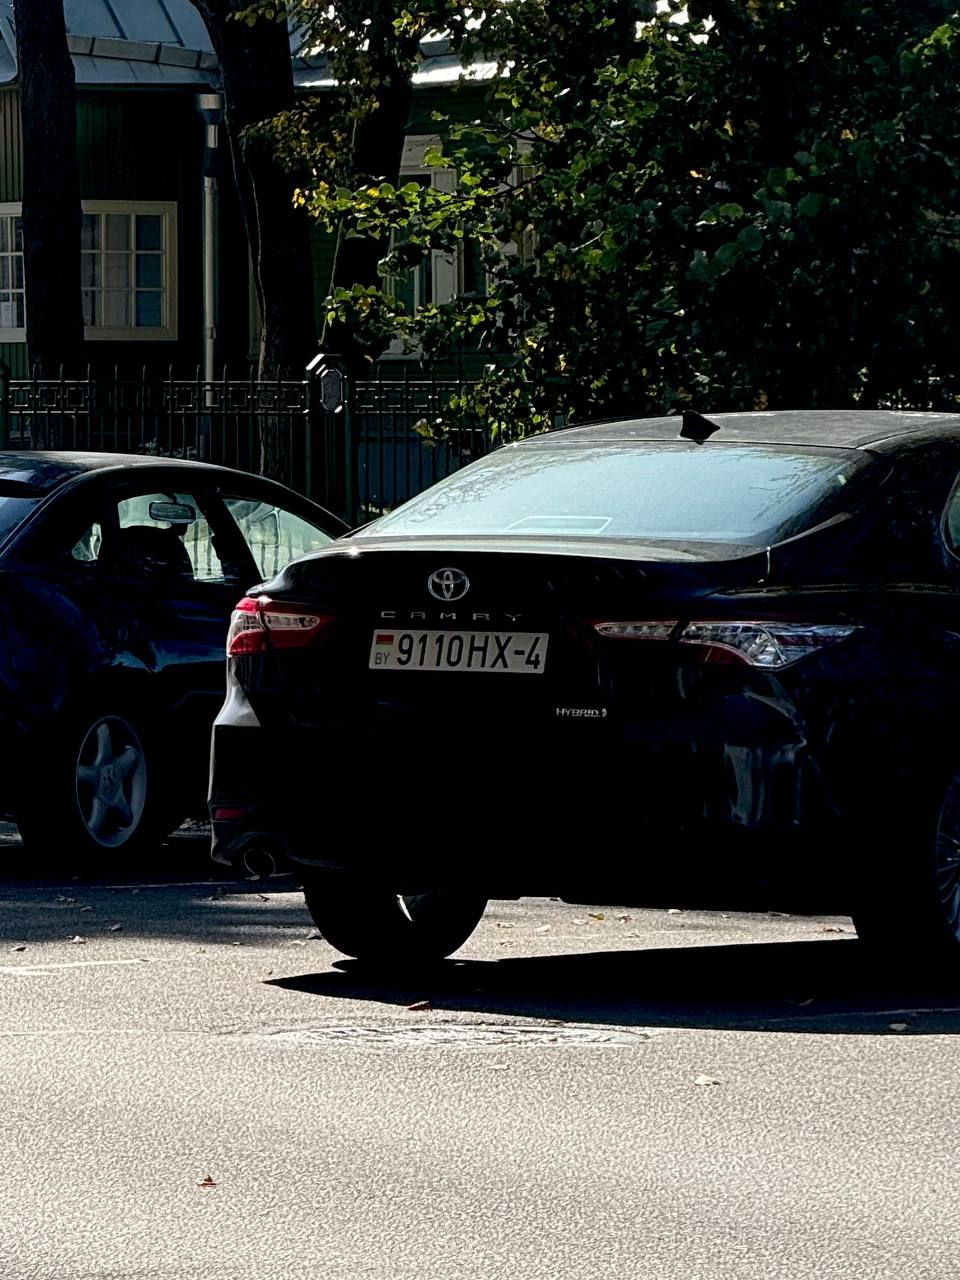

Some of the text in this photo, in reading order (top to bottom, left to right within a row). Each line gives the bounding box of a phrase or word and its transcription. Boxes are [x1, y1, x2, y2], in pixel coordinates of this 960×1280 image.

[380, 611, 523, 622] CAMRY
[397, 634, 541, 669] 9110HX-4
[375, 652, 390, 665] BY
[555, 708, 600, 718] HYBRID
